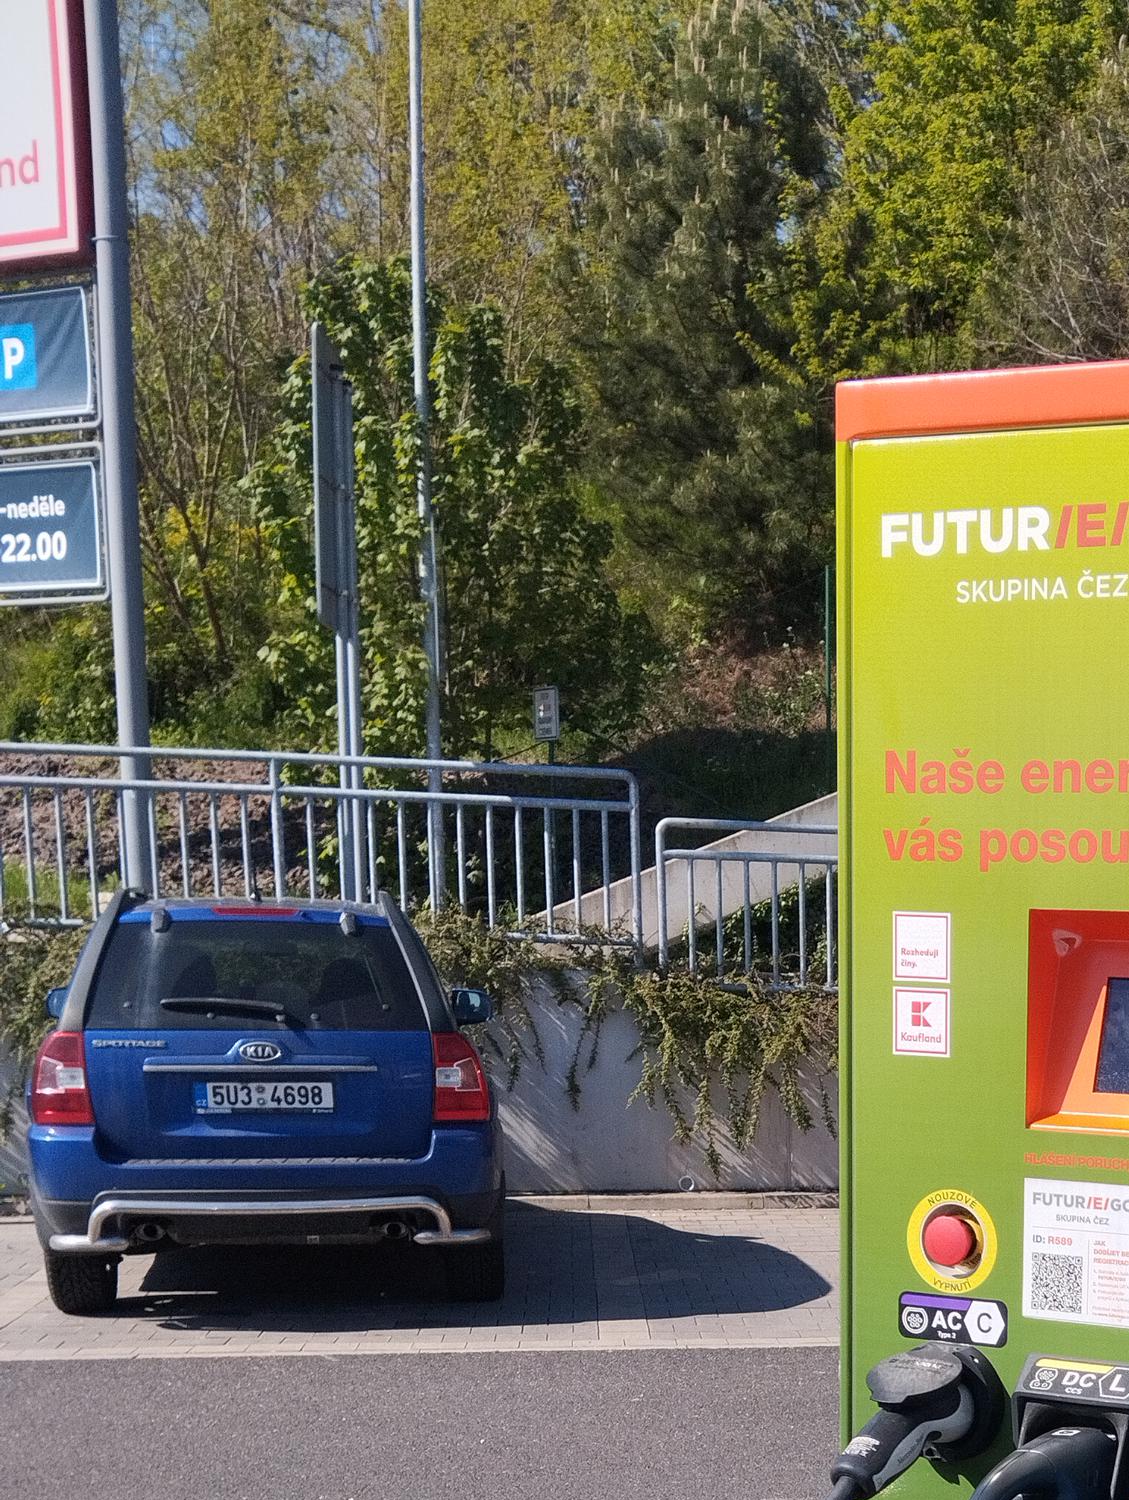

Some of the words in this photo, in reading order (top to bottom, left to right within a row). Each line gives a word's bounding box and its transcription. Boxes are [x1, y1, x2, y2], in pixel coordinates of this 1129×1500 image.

[2, 337, 25, 380] P
[955, 577, 1068, 604] SKUPINA
[1076, 569, 1129, 599] ČEZ
[884, 748, 1005, 795] Naše
[884, 819, 965, 863] vás
[901, 1032, 942, 1043] Kaufland
[246, 1048, 274, 1056] KIA
[212, 1085, 252, 1106] 5U3
[270, 1085, 323, 1106] 4698
[1056, 1214, 1091, 1224] SKUPINA
[1093, 1214, 1110, 1225] ČEZ
[1032, 1234, 1046, 1244] ID:
[931, 1310, 962, 1331] AC
[977, 1312, 993, 1334] C
[937, 1330, 952, 1339] Type
[1062, 1371, 1096, 1388] DC
[1109, 1373, 1126, 1393] L
